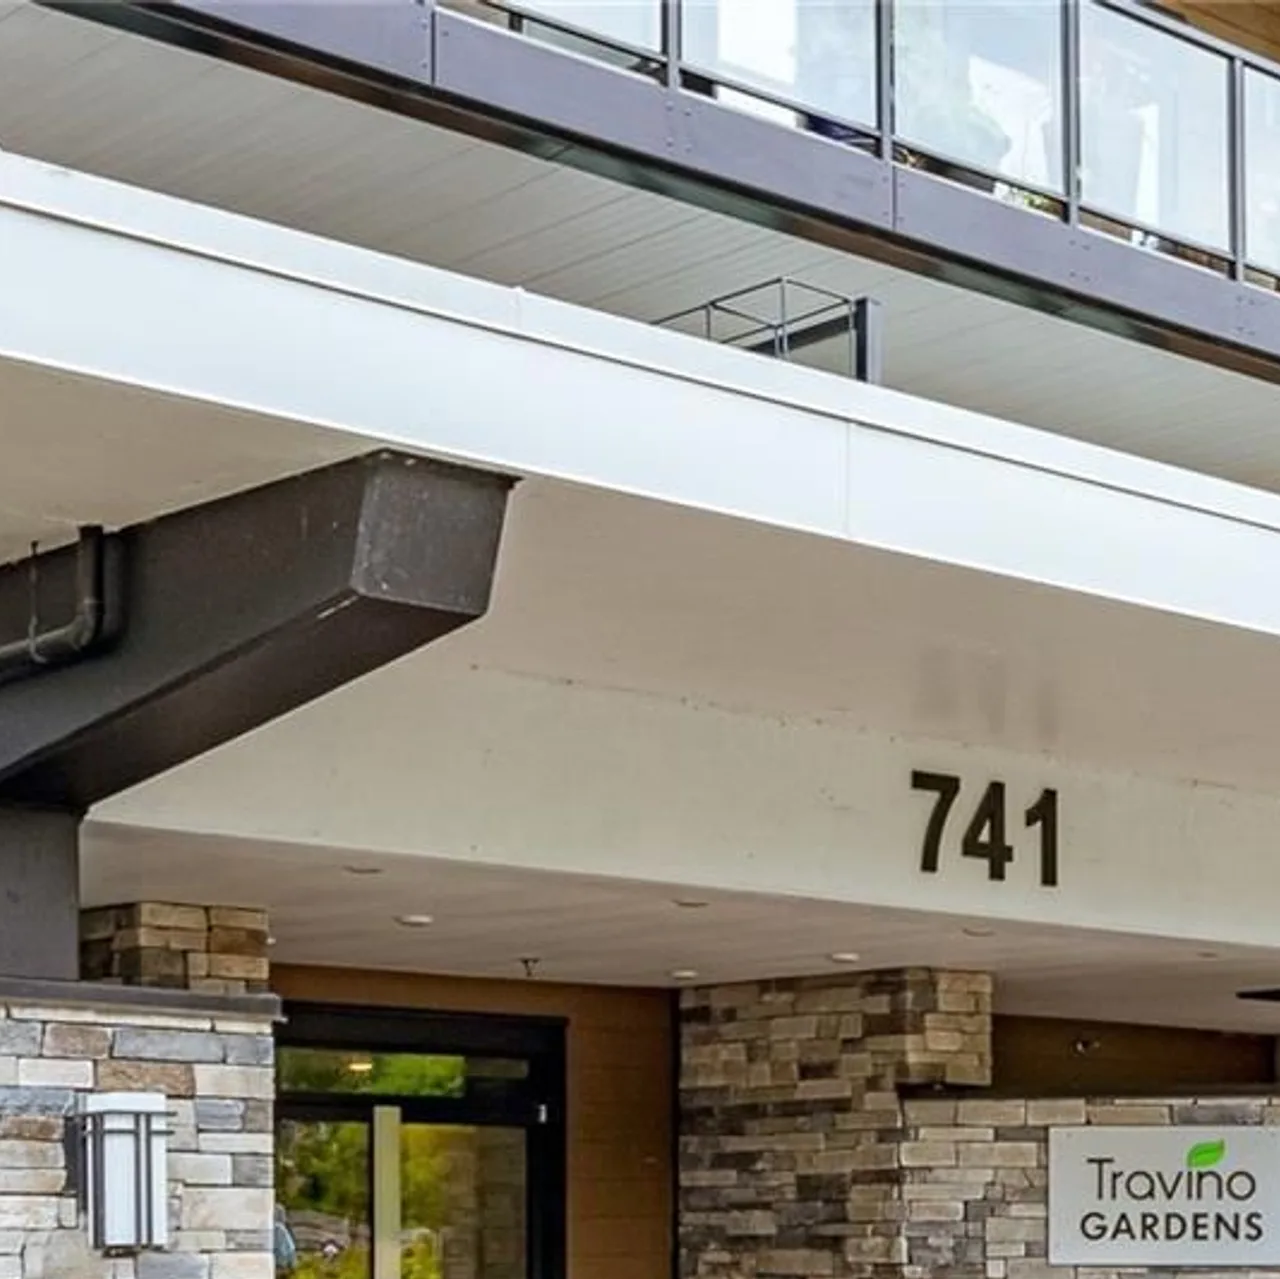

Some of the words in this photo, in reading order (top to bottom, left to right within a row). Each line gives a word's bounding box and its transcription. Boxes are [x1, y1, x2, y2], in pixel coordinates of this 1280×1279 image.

[910, 769, 1059, 887] 741
[1086, 1157, 1257, 1202] Travino
[1080, 1211, 1265, 1242] GARDENS
